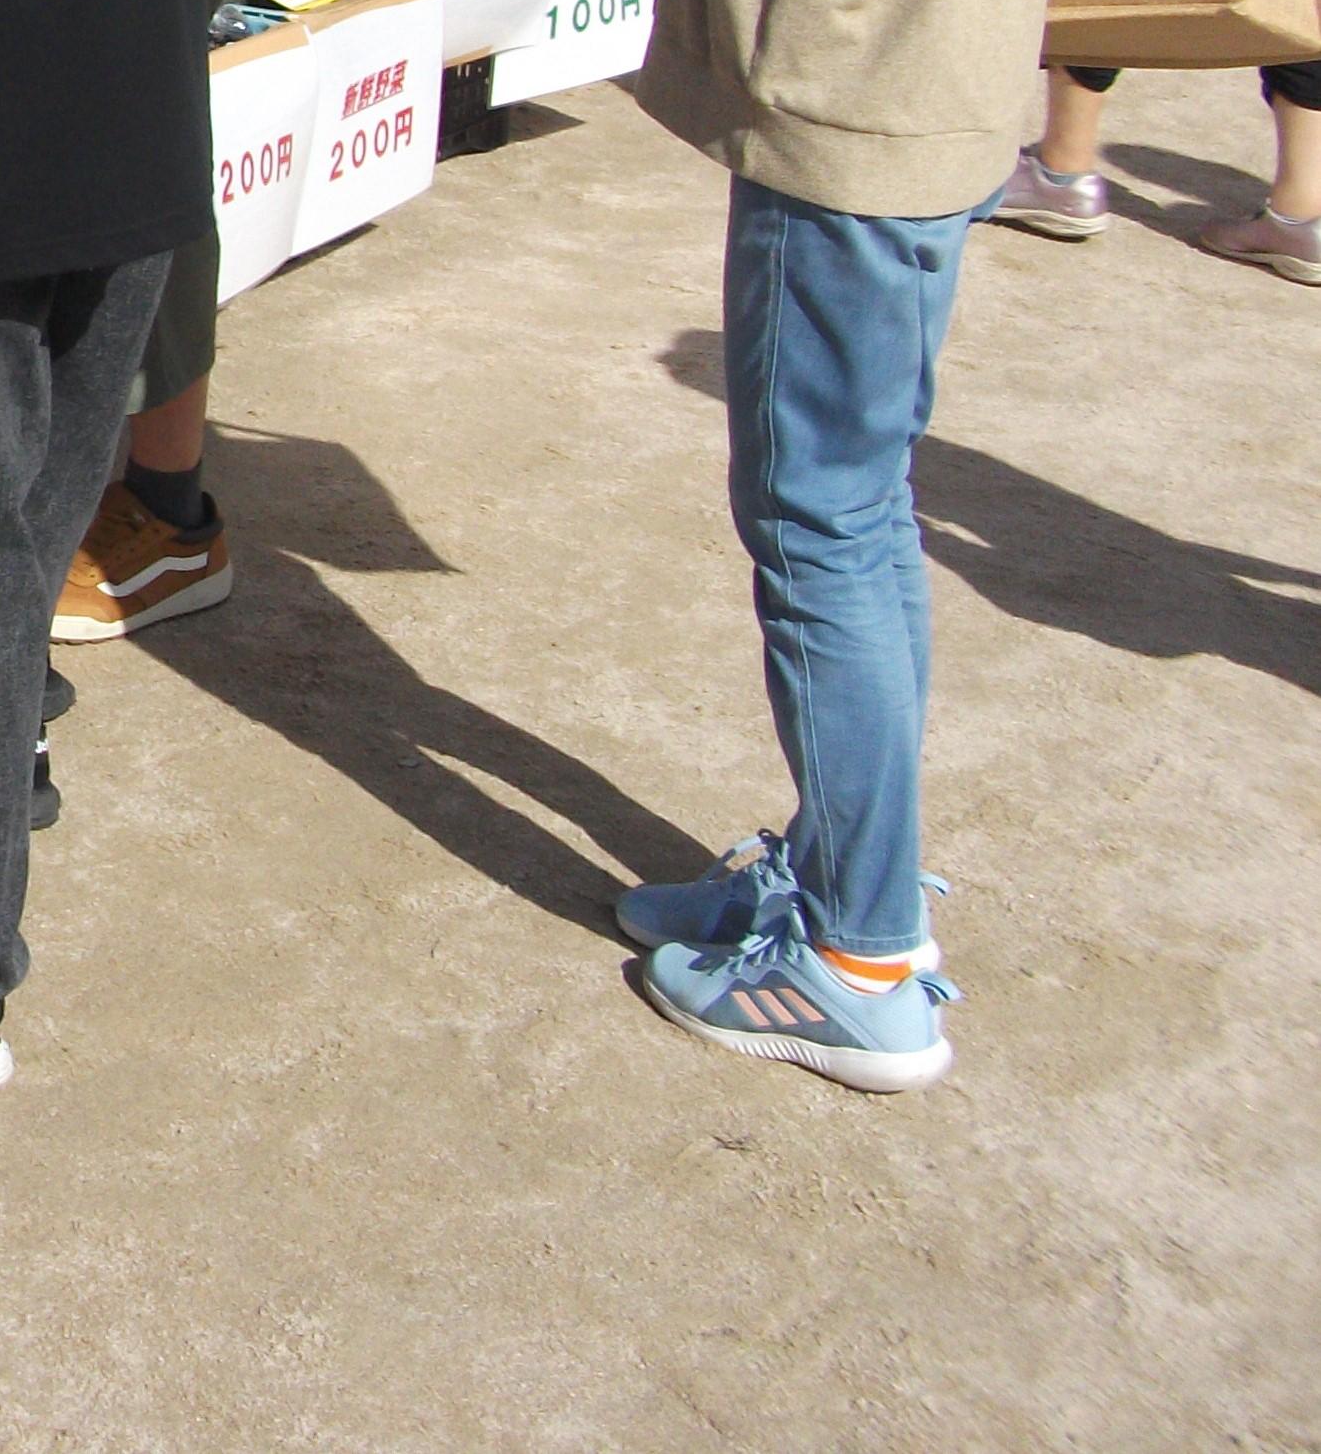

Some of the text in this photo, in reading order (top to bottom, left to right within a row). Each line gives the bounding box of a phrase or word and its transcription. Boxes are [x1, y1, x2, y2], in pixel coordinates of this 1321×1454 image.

[343, 59, 408, 117] 新鮮野菜
[220, 133, 294, 204] 200円
[329, 106, 414, 182] 200円
